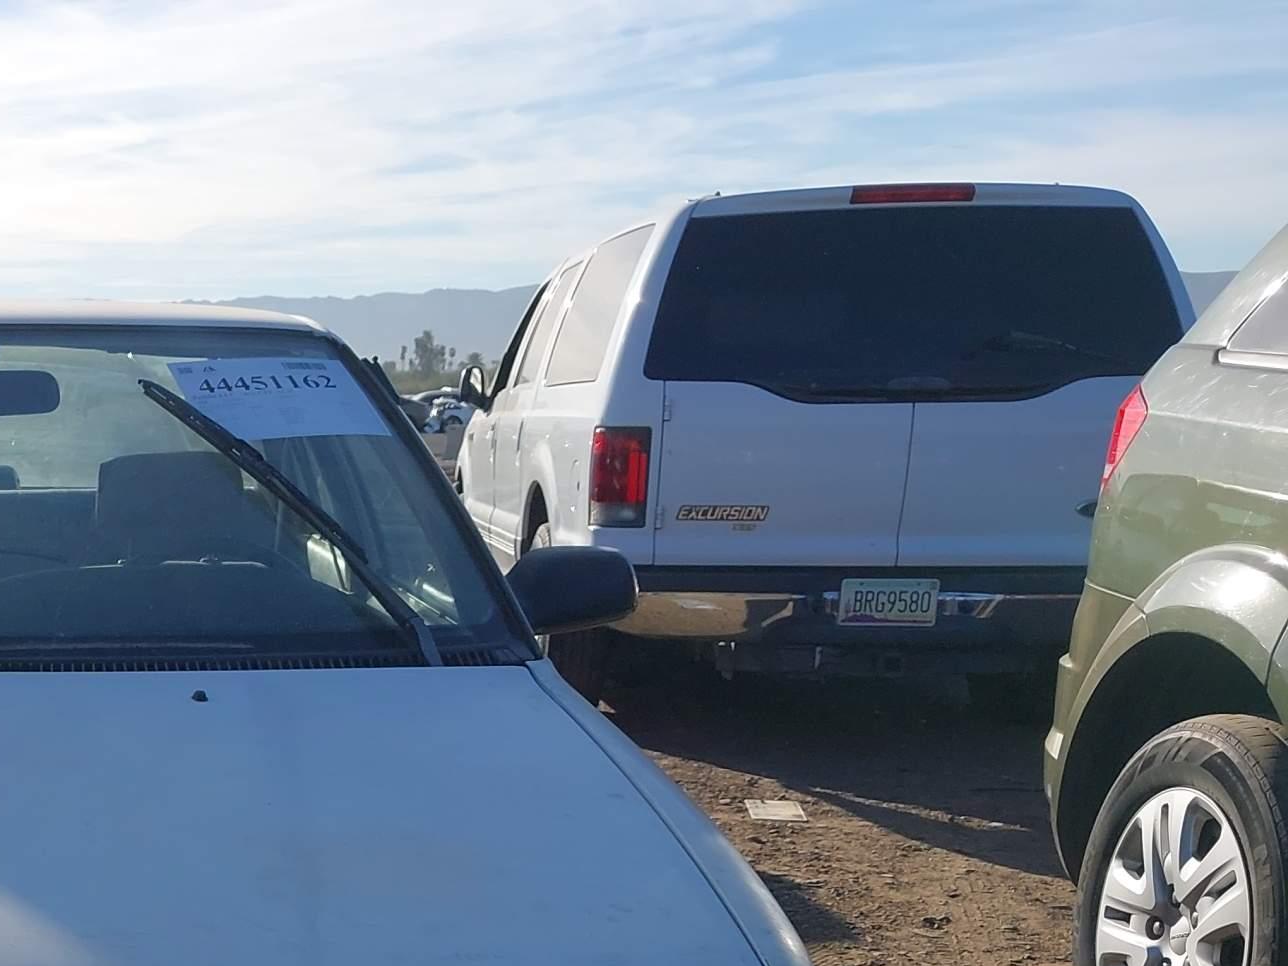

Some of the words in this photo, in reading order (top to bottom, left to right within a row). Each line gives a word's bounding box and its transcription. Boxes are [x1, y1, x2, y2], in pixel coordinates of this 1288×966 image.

[198, 374, 337, 393] 44451162
[677, 506, 768, 520] EXCURSION
[852, 590, 932, 613] BRG9580
